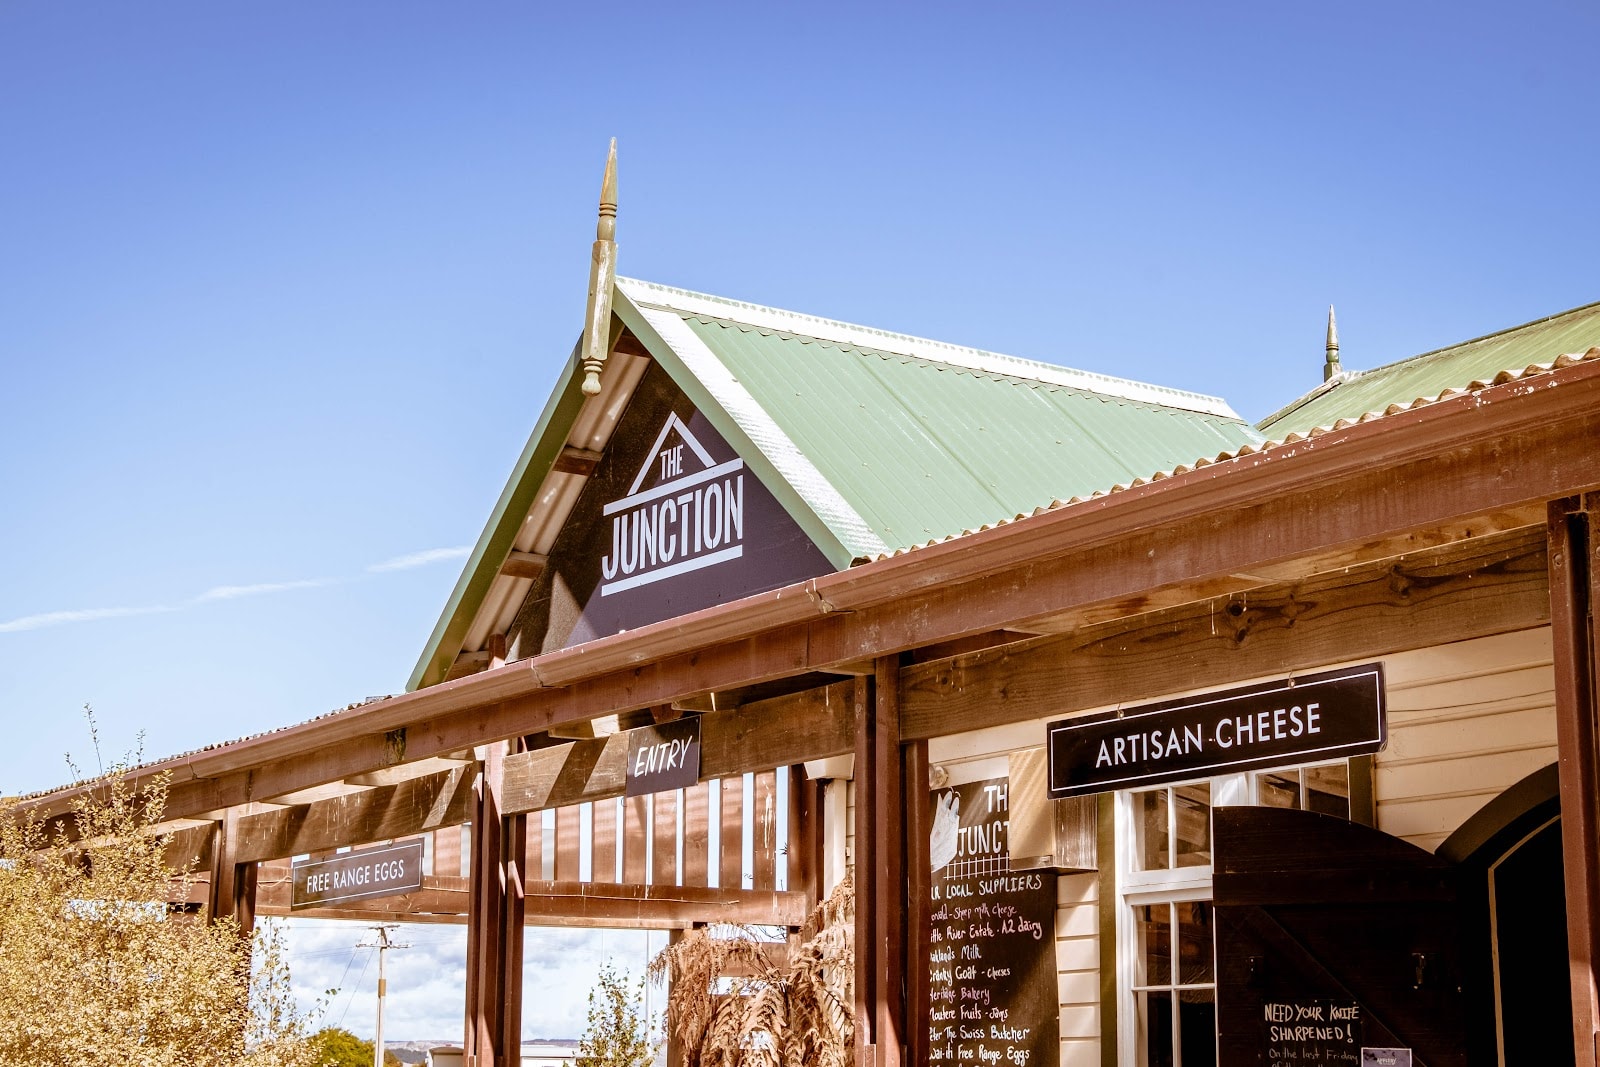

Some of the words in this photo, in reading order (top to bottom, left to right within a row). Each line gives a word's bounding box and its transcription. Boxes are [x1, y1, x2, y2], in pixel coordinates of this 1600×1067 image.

[660, 444, 684, 480] THE
[601, 475, 743, 580] JUNCTION
[1095, 724, 1202, 769] ARTISAN
[1215, 703, 1321, 749] CHEESE
[634, 735, 693, 778] ENTRY
[984, 784, 1008, 813] TH
[958, 820, 1009, 857] JUNCT
[306, 873, 329, 894] FREE
[333, 866, 370, 889] RANGE
[375, 860, 404, 882] EGGS
[946, 884, 973, 899] LOCAL
[978, 874, 1042, 896] SUPPLIERS
[931, 927, 943, 943] ittle
[947, 926, 966, 940] River
[970, 922, 995, 938] Estate
[1002, 919, 1015, 934] A2
[1018, 916, 1042, 940] dairy
[961, 944, 982, 960] Milk
[955, 965, 977, 980] Goat
[960, 987, 990, 1005] Bakery
[960, 1003, 982, 1020] Fruits
[1264, 1003, 1293, 1022] NEED
[1295, 1004, 1324, 1022] YOUR
[1330, 1004, 1360, 1022] KNIFE
[944, 1026, 957, 1043] The
[960, 1025, 985, 1039] Swiss
[990, 1024, 1030, 1042] Butcher
[958, 1044, 974, 1060] Free
[979, 1044, 1003, 1066] Range
[1007, 1046, 1030, 1067] Eggs
[1269, 1048, 1281, 1058] On
[1284, 1048, 1297, 1058] the
[1302, 1048, 1320, 1059] last
[1326, 1049, 1358, 1065] Friday
